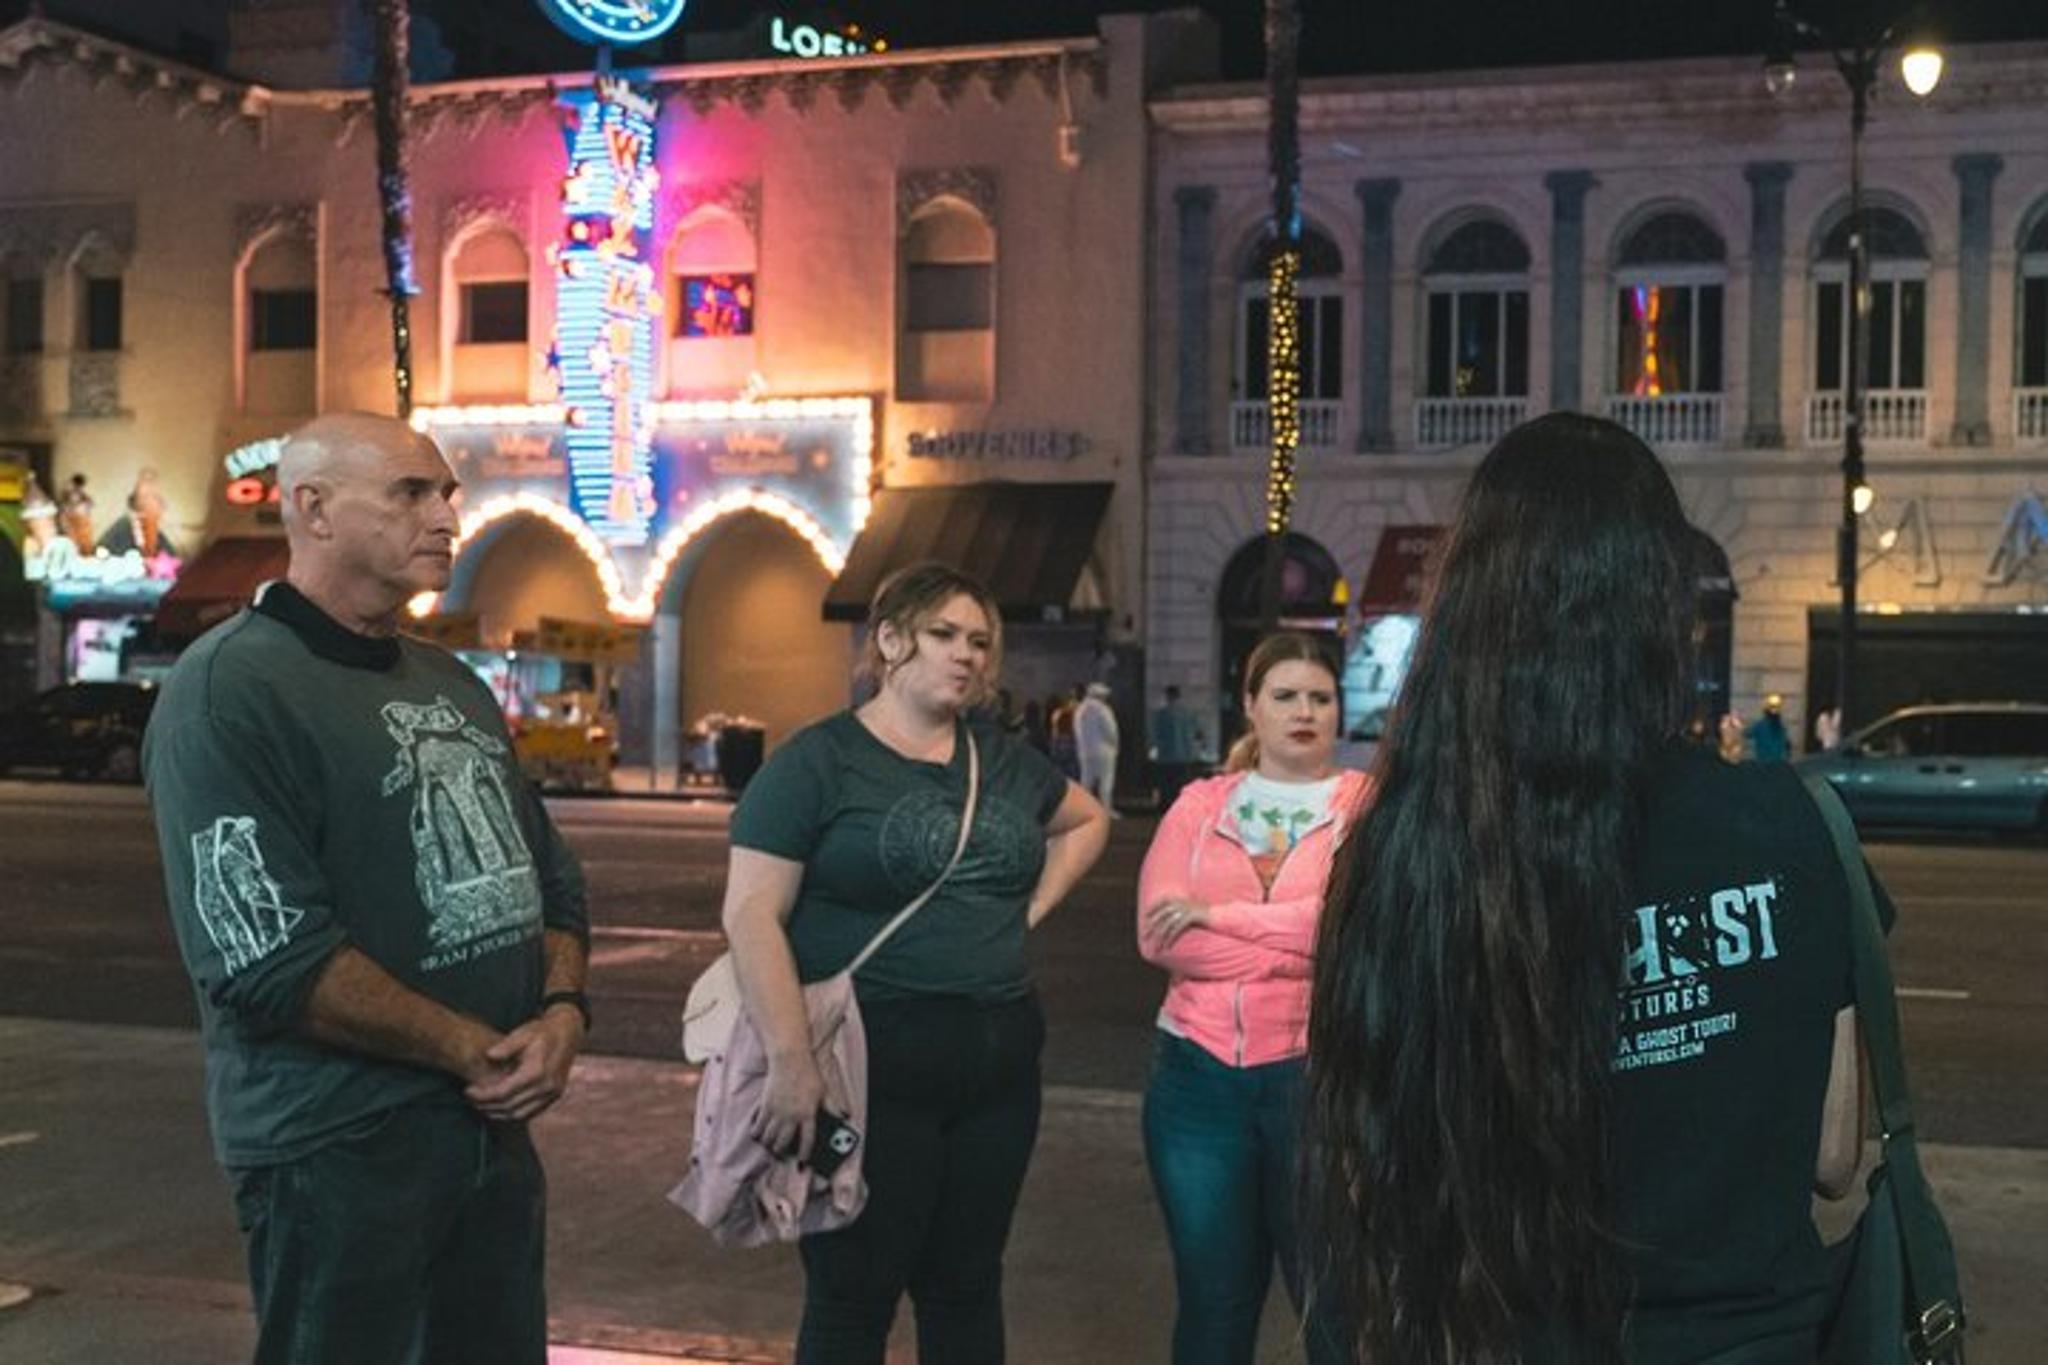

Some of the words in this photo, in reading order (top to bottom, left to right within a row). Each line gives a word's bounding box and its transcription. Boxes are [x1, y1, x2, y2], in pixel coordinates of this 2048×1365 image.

[1620, 879, 1778, 984] HOST
[1620, 985, 1710, 1021] TURES
[1636, 1023, 1688, 1050] GHOST
